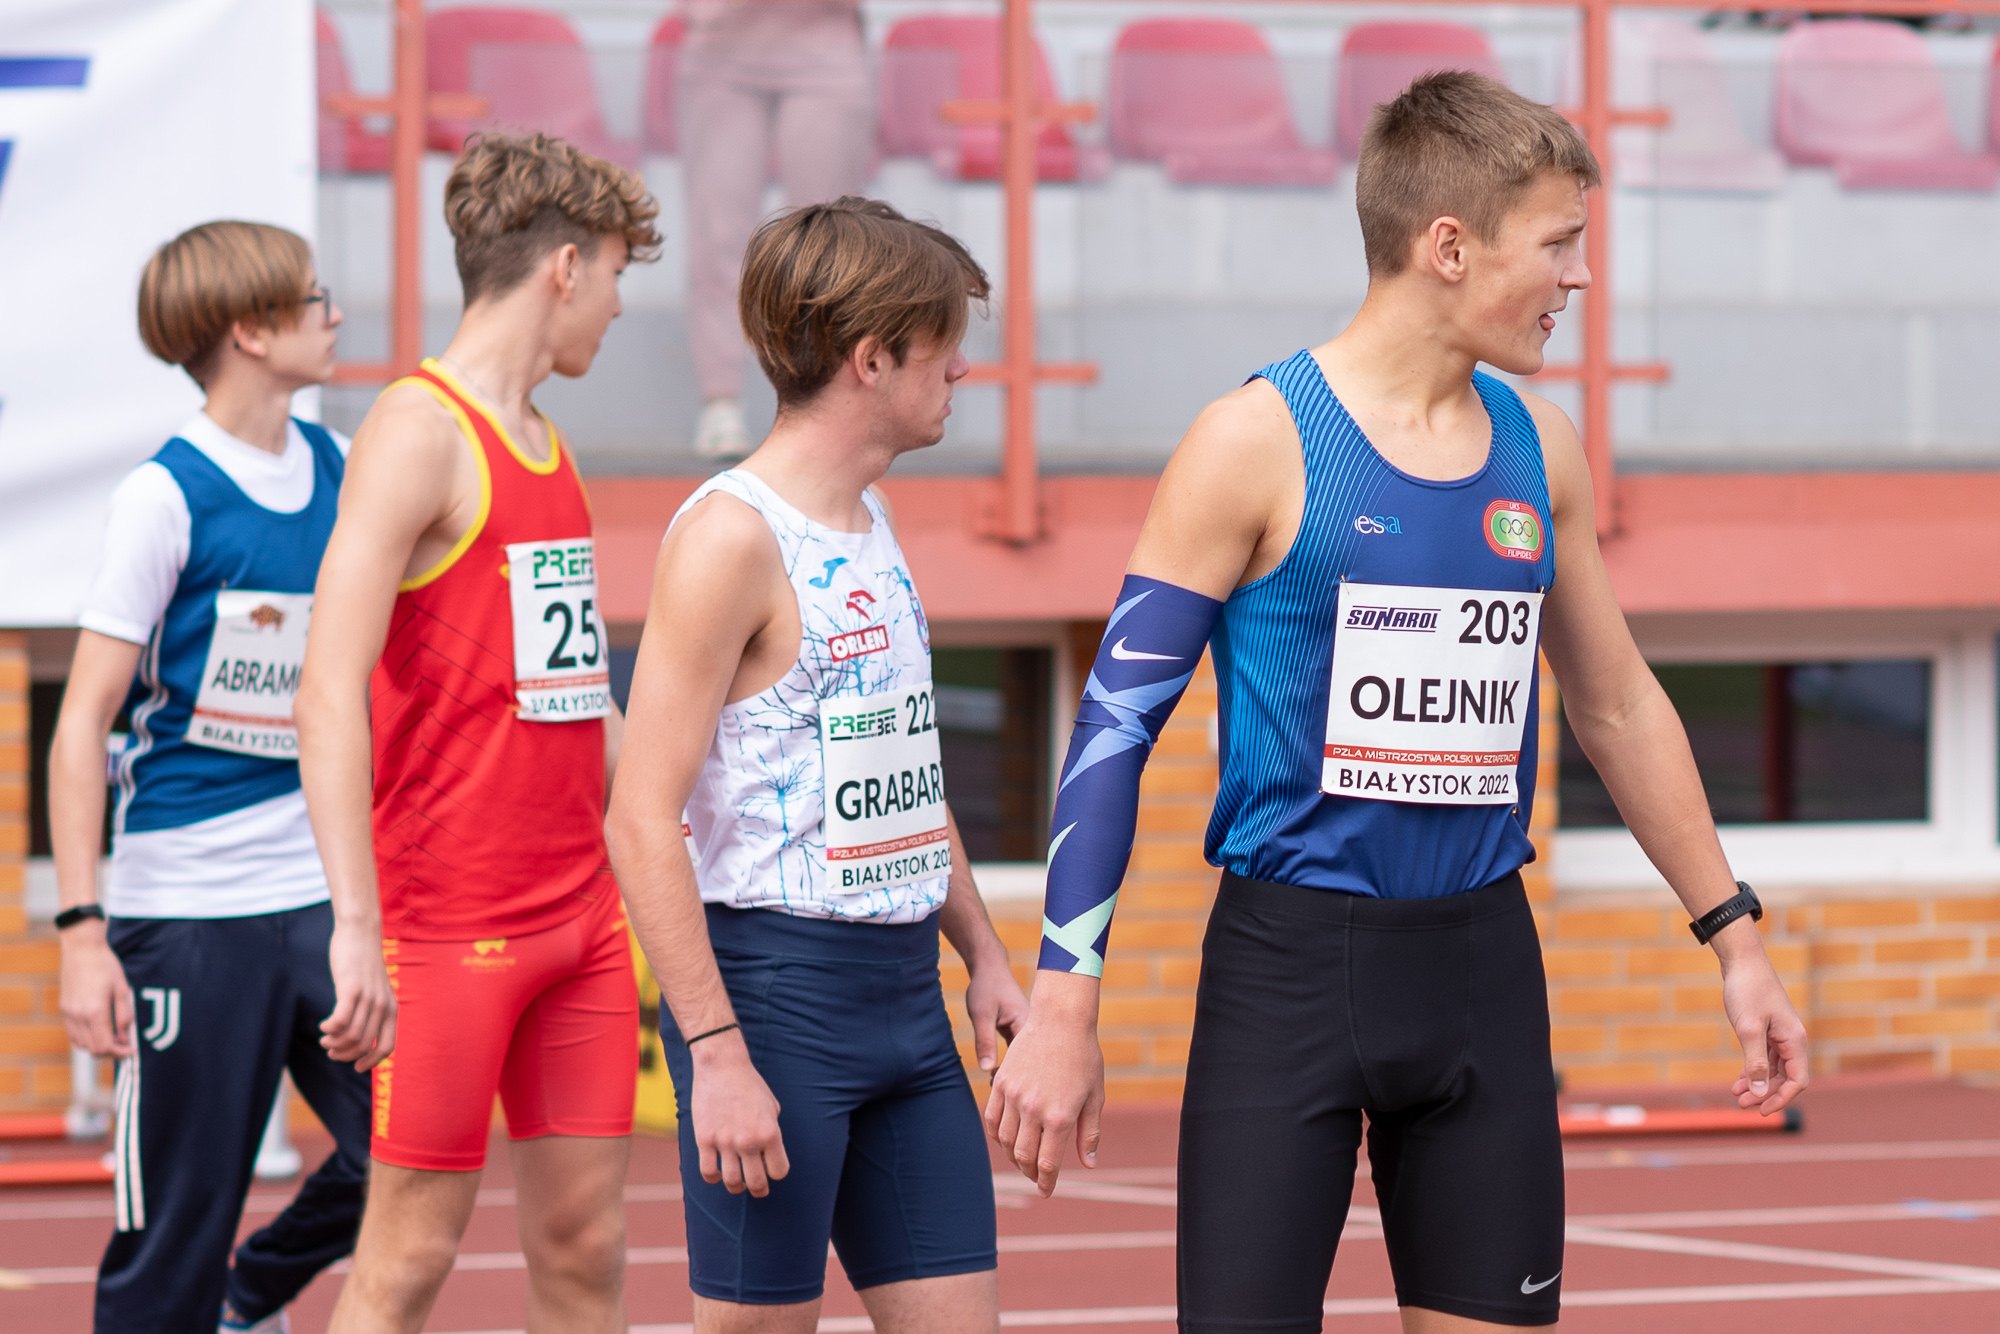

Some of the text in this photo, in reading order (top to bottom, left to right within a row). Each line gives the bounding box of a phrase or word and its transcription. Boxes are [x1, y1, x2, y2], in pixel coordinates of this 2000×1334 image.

[1507, 549, 1533, 560] FILIPIDES
[543, 599, 606, 670] 25
[1346, 599, 1530, 645] SONAROL 203
[831, 628, 887, 659] ORLEN
[211, 658, 302, 696] ABRAM
[1350, 675, 1520, 724] OLEJNIK
[202, 725, 299, 751] BIAŁYSTO
[1333, 747, 1363, 758] PZLA
[1365, 750, 1442, 762] MISTRZOSTWA
[1443, 754, 1473, 763] POLSKI
[1475, 754, 1482, 763] W
[836, 763, 944, 821] GRABAR
[1340, 768, 1509, 795] BIAŁYSTOK 2022
[832, 848, 859, 858] PZLA
[842, 853, 929, 887] BIAŁYSTOK
